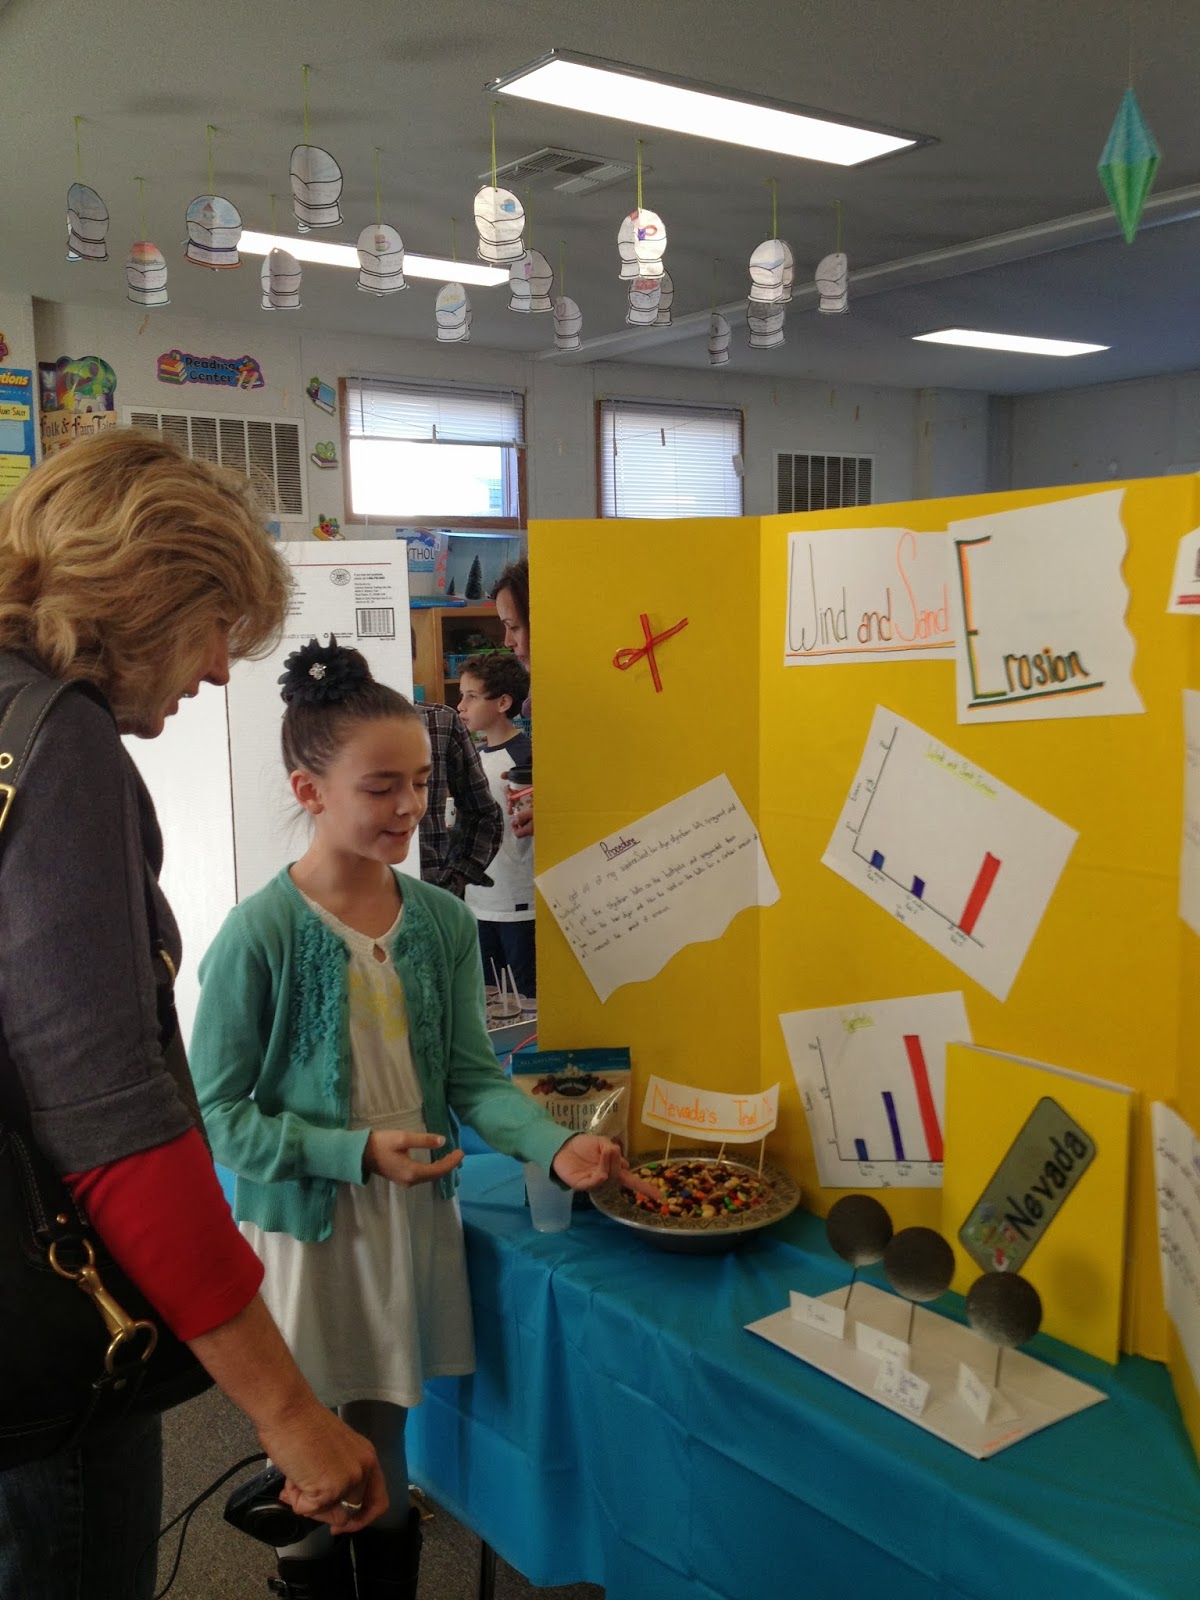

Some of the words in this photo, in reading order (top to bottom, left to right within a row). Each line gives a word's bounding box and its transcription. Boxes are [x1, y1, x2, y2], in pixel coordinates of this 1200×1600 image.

[185, 358, 237, 372] Reading
[189, 370, 233, 382] Center
[61, 417, 70, 435] &
[409, 547, 434, 560] THOL
[789, 541, 848, 651] Wind
[857, 587, 893, 643] and
[894, 531, 949, 642] Sand
[954, 535, 1090, 700] Erosion
[599, 836, 636, 858] Procedure
[582, 883, 590, 894] all
[595, 875, 602, 885] of
[606, 871, 618, 881] my
[652, 1084, 717, 1125] Nevada's
[1004, 1131, 1088, 1241] Nevada
